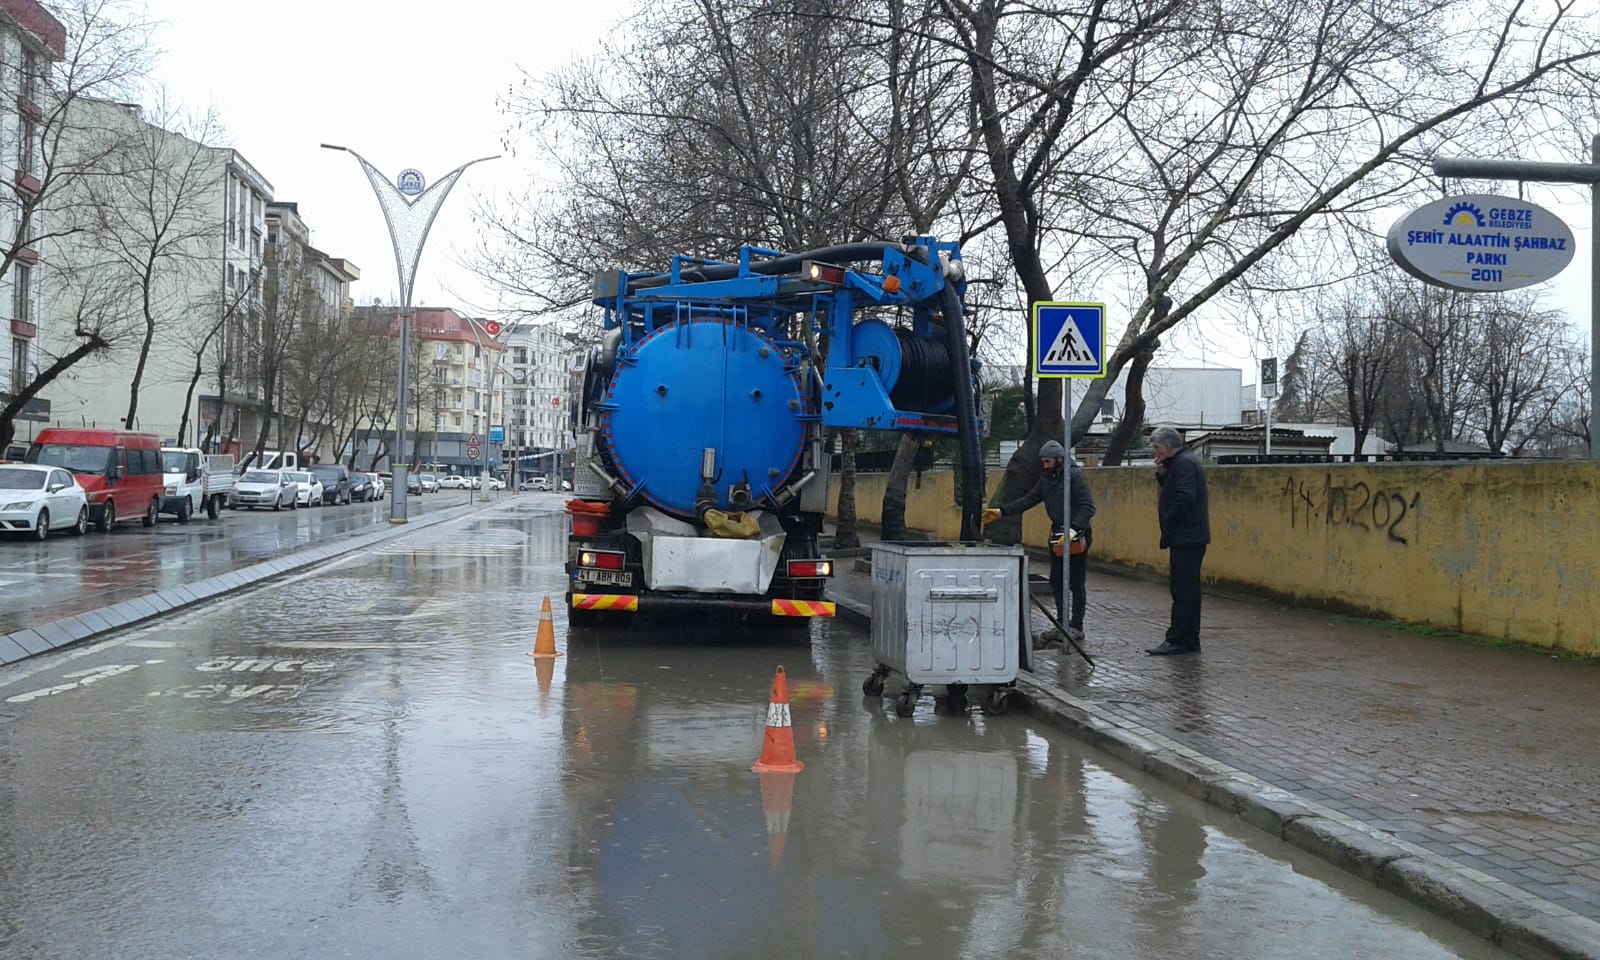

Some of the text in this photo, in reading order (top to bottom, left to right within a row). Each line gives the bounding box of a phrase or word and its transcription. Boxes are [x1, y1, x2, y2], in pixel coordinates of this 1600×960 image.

[1489, 208, 1532, 221] GEBZE
[1407, 229, 1566, 252] ŞEHİT ALAATTİN ŞAHBAZ
[1466, 252, 1507, 266] PARKI
[1471, 268, 1503, 282] 2011
[580, 569, 590, 580] 41
[596, 571, 612, 581] ABH
